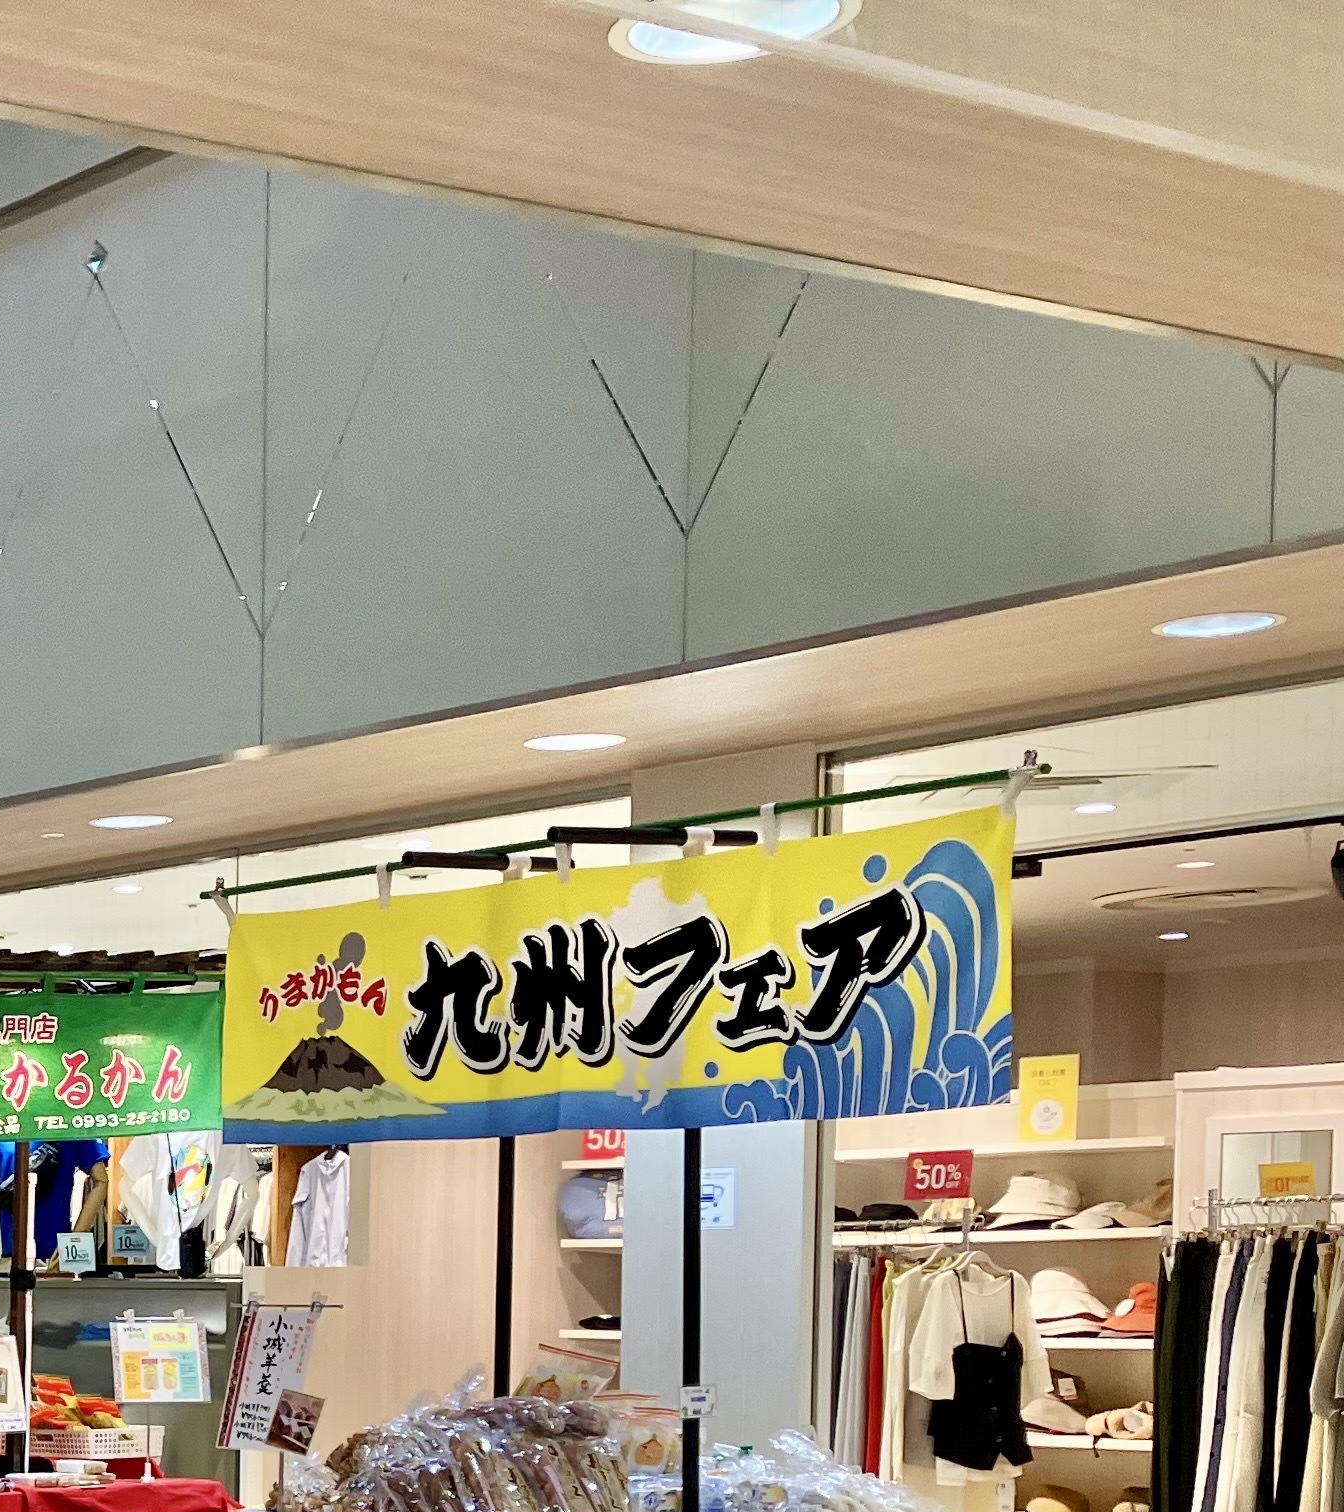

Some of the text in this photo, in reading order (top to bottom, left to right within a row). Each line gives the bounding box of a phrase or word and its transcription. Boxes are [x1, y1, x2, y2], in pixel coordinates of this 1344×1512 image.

[256, 960, 391, 1024] うまかもん
[402, 884, 927, 1080] 九州フェア
[2, 1045, 193, 1110] かるかん
[33, 1115, 70, 1132] TEL
[71, 1108, 191, 1130] 0993-25-2180
[914, 1163, 962, 1190] 50%
